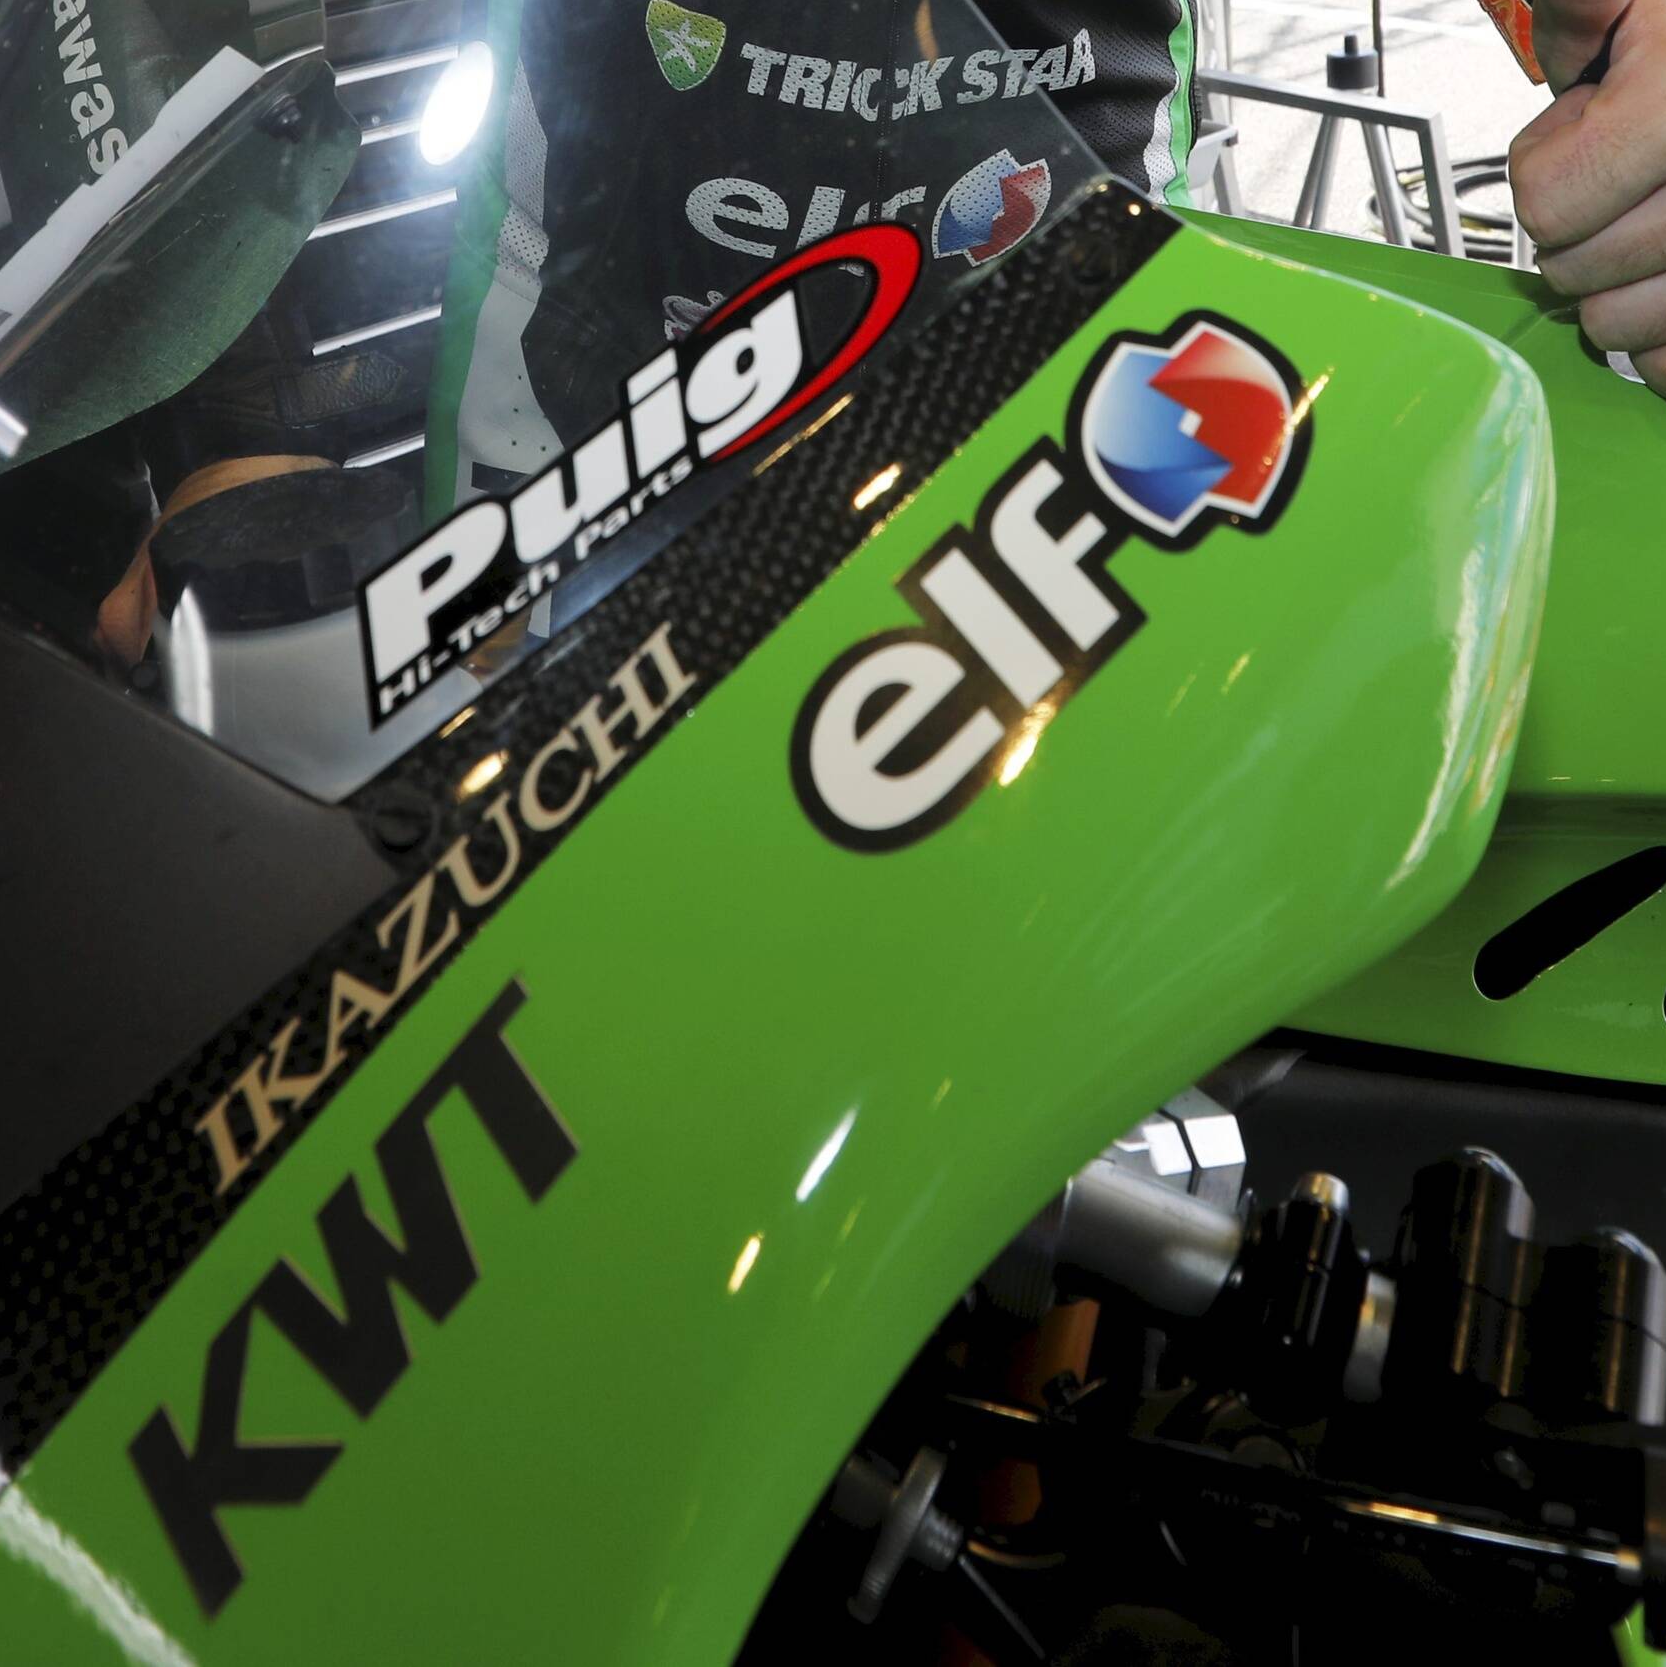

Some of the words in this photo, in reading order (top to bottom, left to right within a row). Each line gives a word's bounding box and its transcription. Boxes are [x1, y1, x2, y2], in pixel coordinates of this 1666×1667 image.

[740, 42, 958, 122] TRICK
[956, 28, 1097, 105] STAR
[364, 288, 803, 686] Puig
[379, 561, 560, 715] Hi-Tech
[575, 453, 694, 561] Parts
[806, 457, 1123, 833] elf
[194, 622, 698, 1196] IKAZUCHI
[126, 970, 581, 1625] KWT
